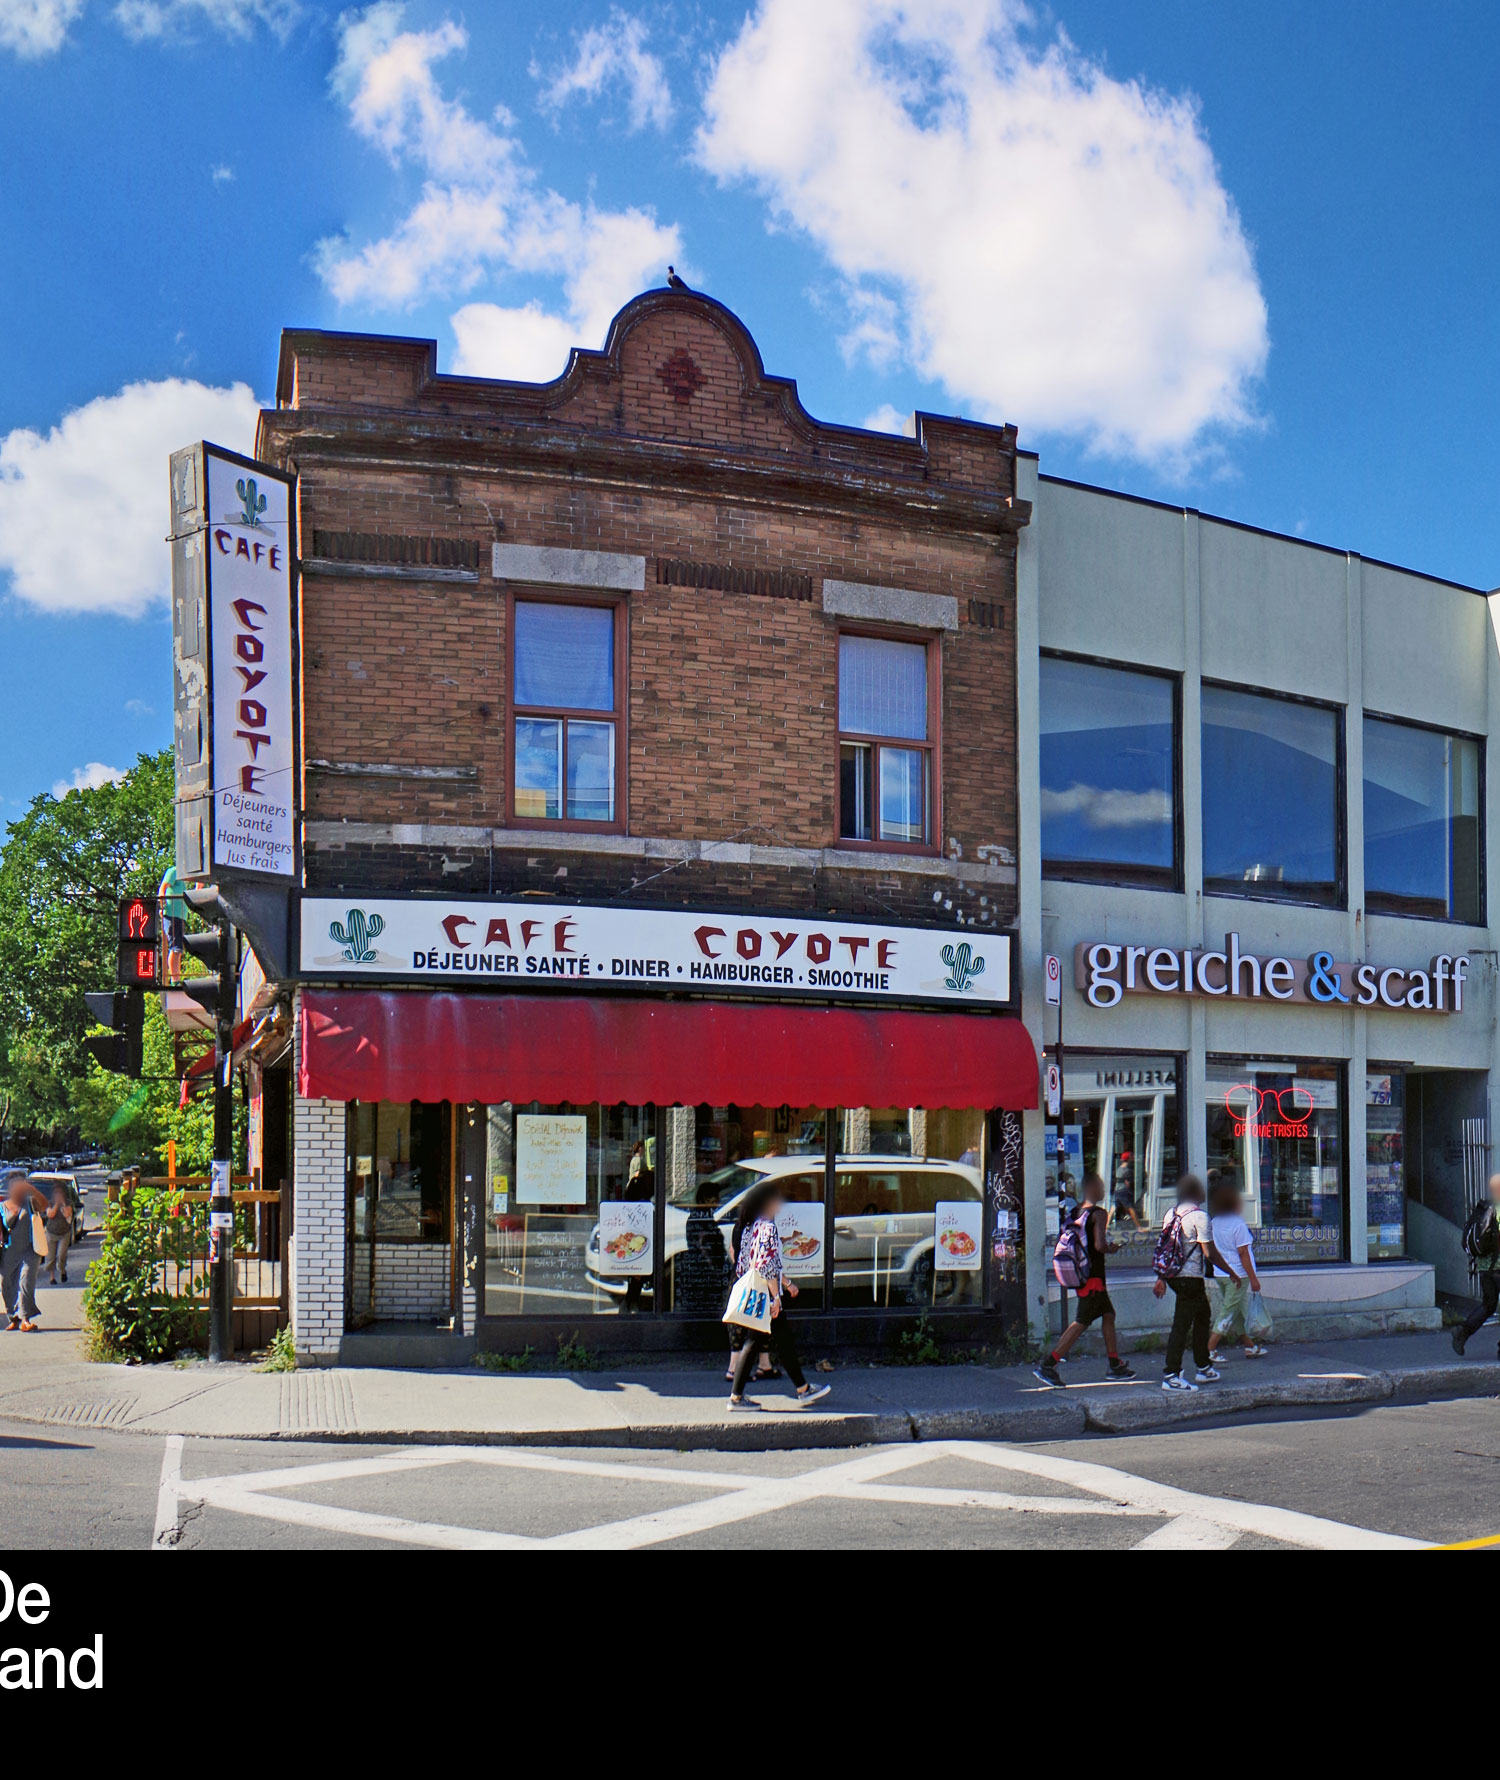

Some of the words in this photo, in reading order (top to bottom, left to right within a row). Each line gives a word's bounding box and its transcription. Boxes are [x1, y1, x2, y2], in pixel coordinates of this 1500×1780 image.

[215, 528, 282, 573] CAFÉ
[231, 598, 271, 796] COYOTE
[223, 792, 287, 818] Déjeuners
[217, 828, 292, 856] Hamburgers
[236, 816, 273, 833] santé
[223, 849, 246, 866] Jus
[250, 851, 280, 870] frais
[441, 914, 578, 953] CAFÉ
[693, 925, 899, 970] COYOTE
[413, 947, 519, 973] DÉJEUNER
[525, 953, 590, 976] SANTÉ
[611, 958, 670, 978] DINER
[690, 962, 794, 984] HAMBURGER
[808, 968, 889, 990] SMOOTHIE
[1085, 932, 1296, 1009] greiche
[1307, 950, 1350, 1003] &
[1355, 954, 1471, 1011] scaff
[1234, 1121, 1309, 1138] OPTOMÉTRISTES
